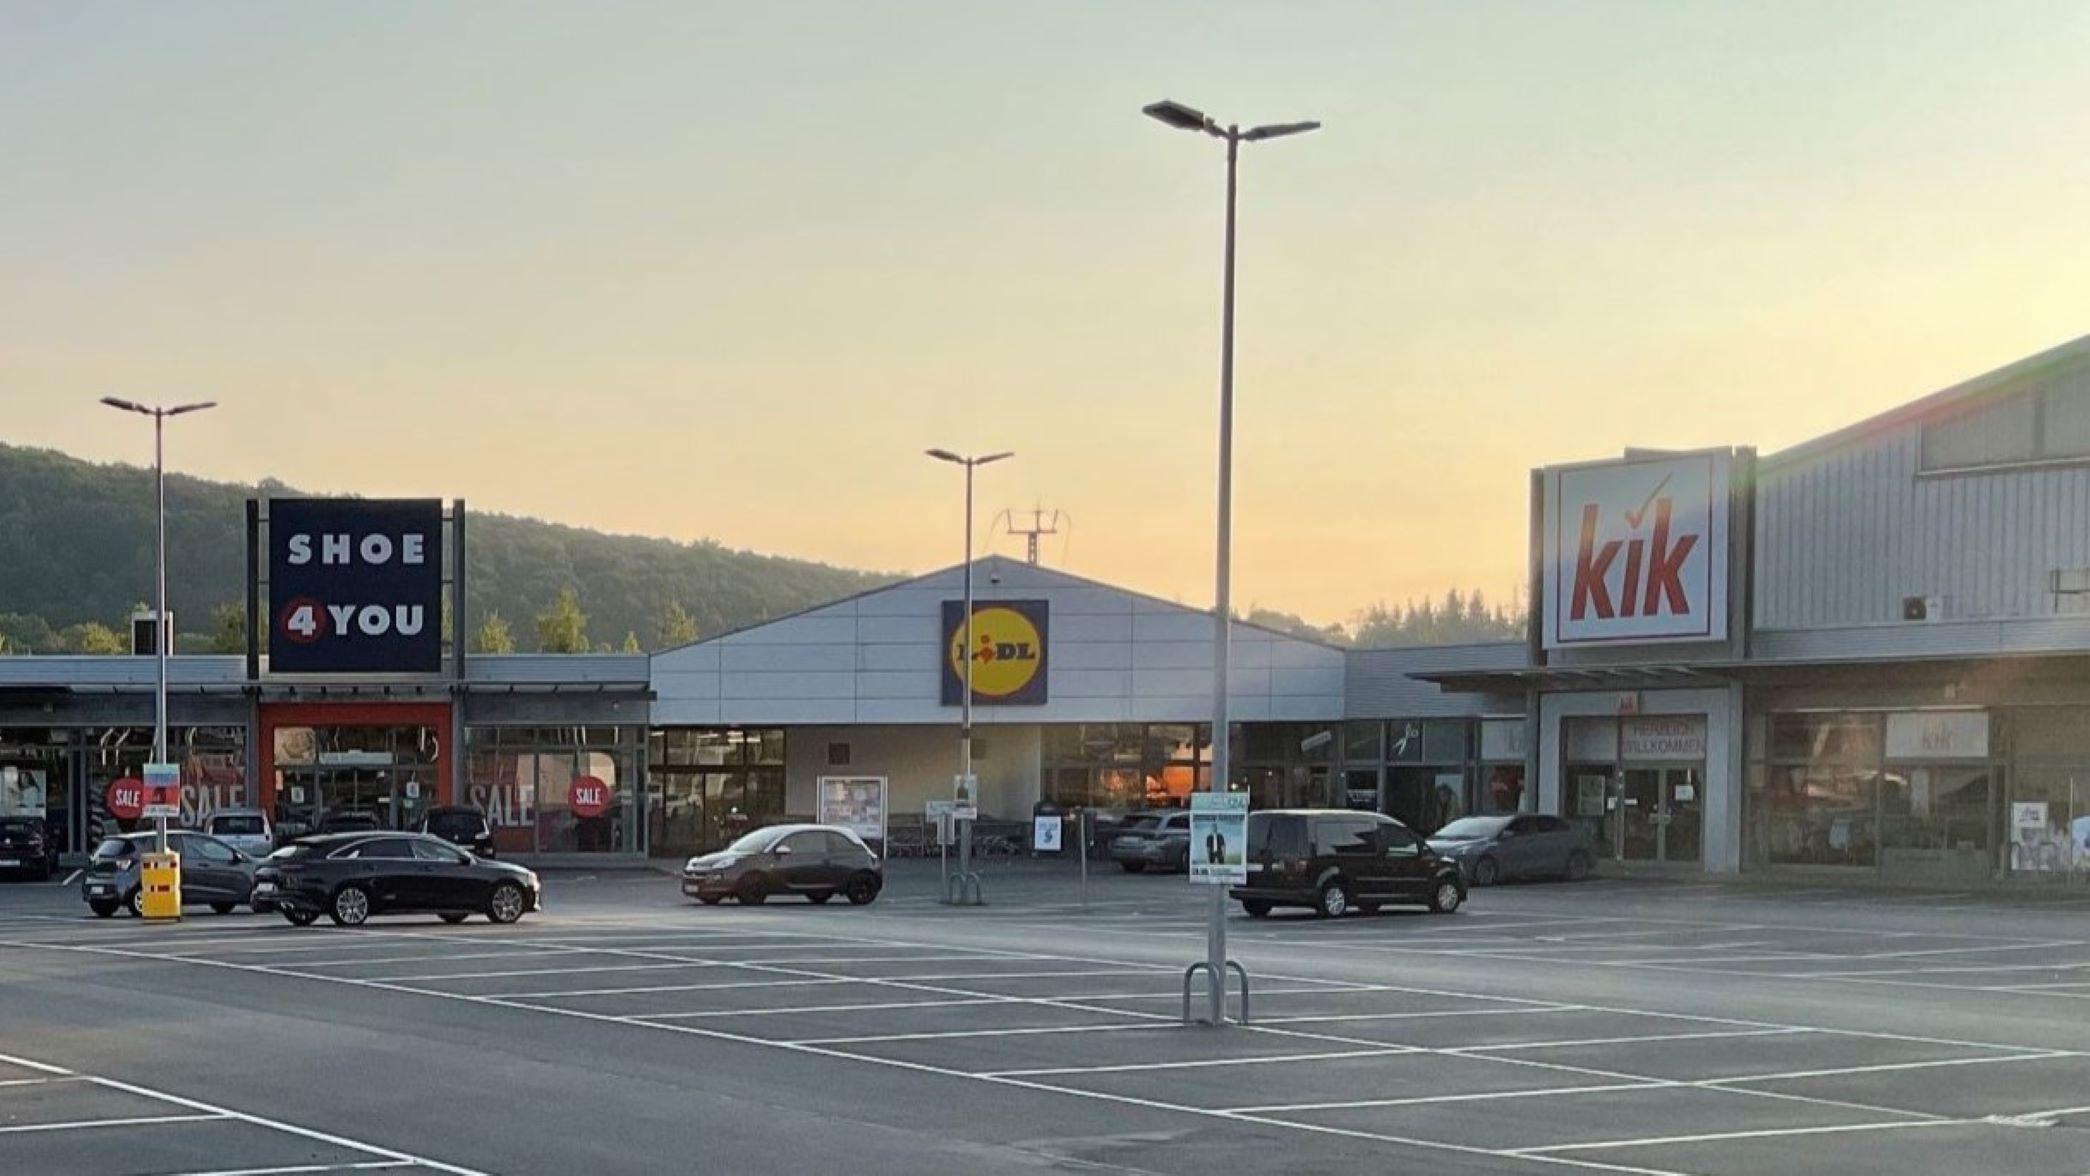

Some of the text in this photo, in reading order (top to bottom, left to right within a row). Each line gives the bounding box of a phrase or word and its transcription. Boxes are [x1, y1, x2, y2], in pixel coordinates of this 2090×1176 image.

[288, 534, 424, 564] SHOE
[115, 789, 141, 807] SALE
[469, 785, 534, 826] SALE
[576, 788, 601, 805] SALE
